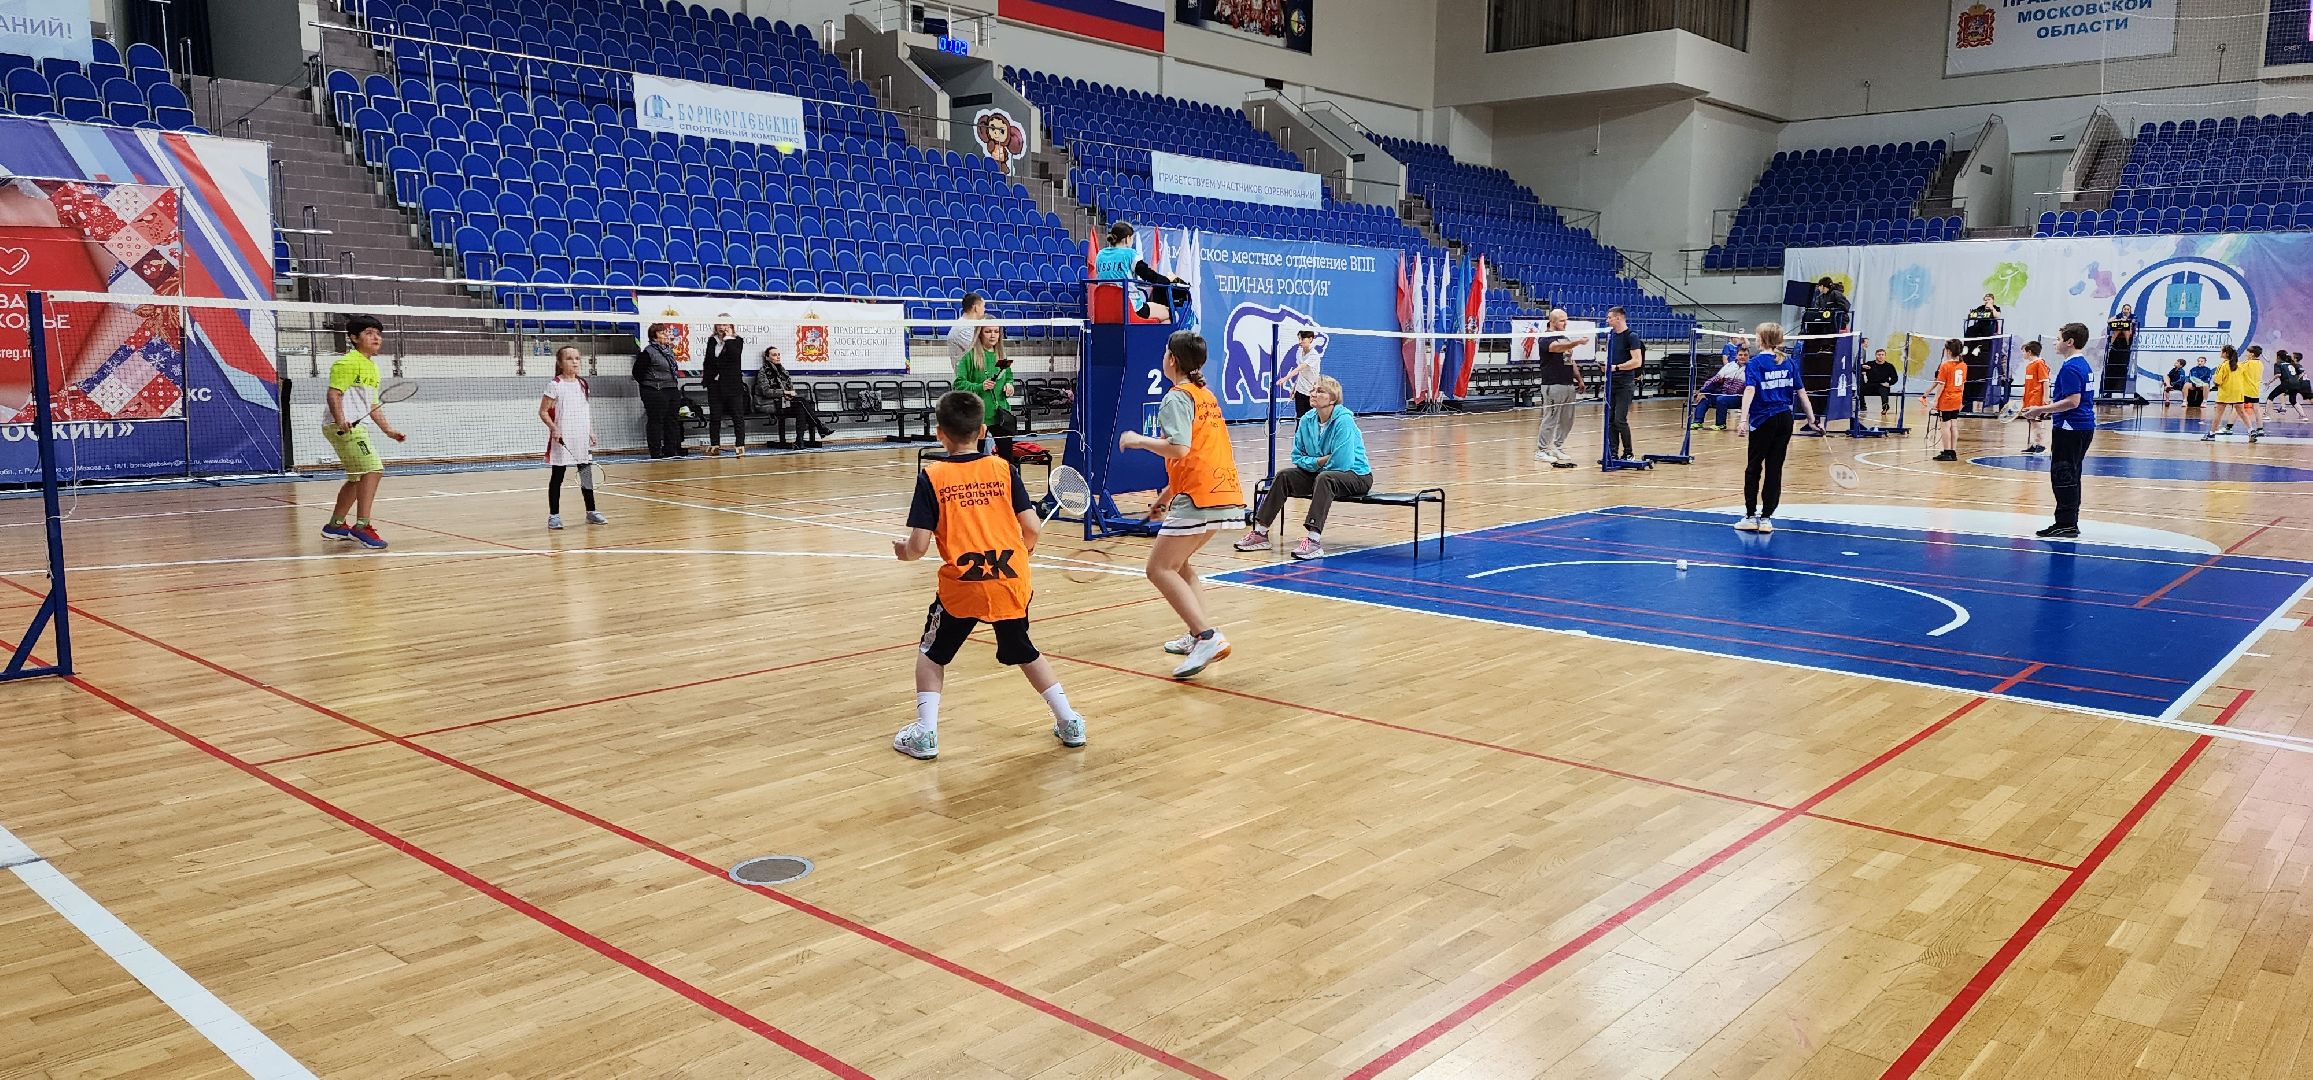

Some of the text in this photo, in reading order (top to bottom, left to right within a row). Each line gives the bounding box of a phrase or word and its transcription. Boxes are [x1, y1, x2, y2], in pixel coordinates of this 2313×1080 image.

[2036, 17, 2128, 39] ОБЛАСТИ
[678, 103, 799, 136] БОРИСОГЛЕБСКИЙ
[1158, 171, 1317, 200] ПРИВЕТСТВУЕМ УЧАСТНИКОВ СОРЕВНОВАНИЙ!
[1231, 250, 1282, 266] местное
[1285, 254, 1347, 271] отделение
[1350, 255, 1376, 272] ВПП
[1147, 368, 1163, 395] 2
[939, 481, 1005, 497] РОССИЙСКИЙ
[960, 498, 990, 508] СОЮЗ
